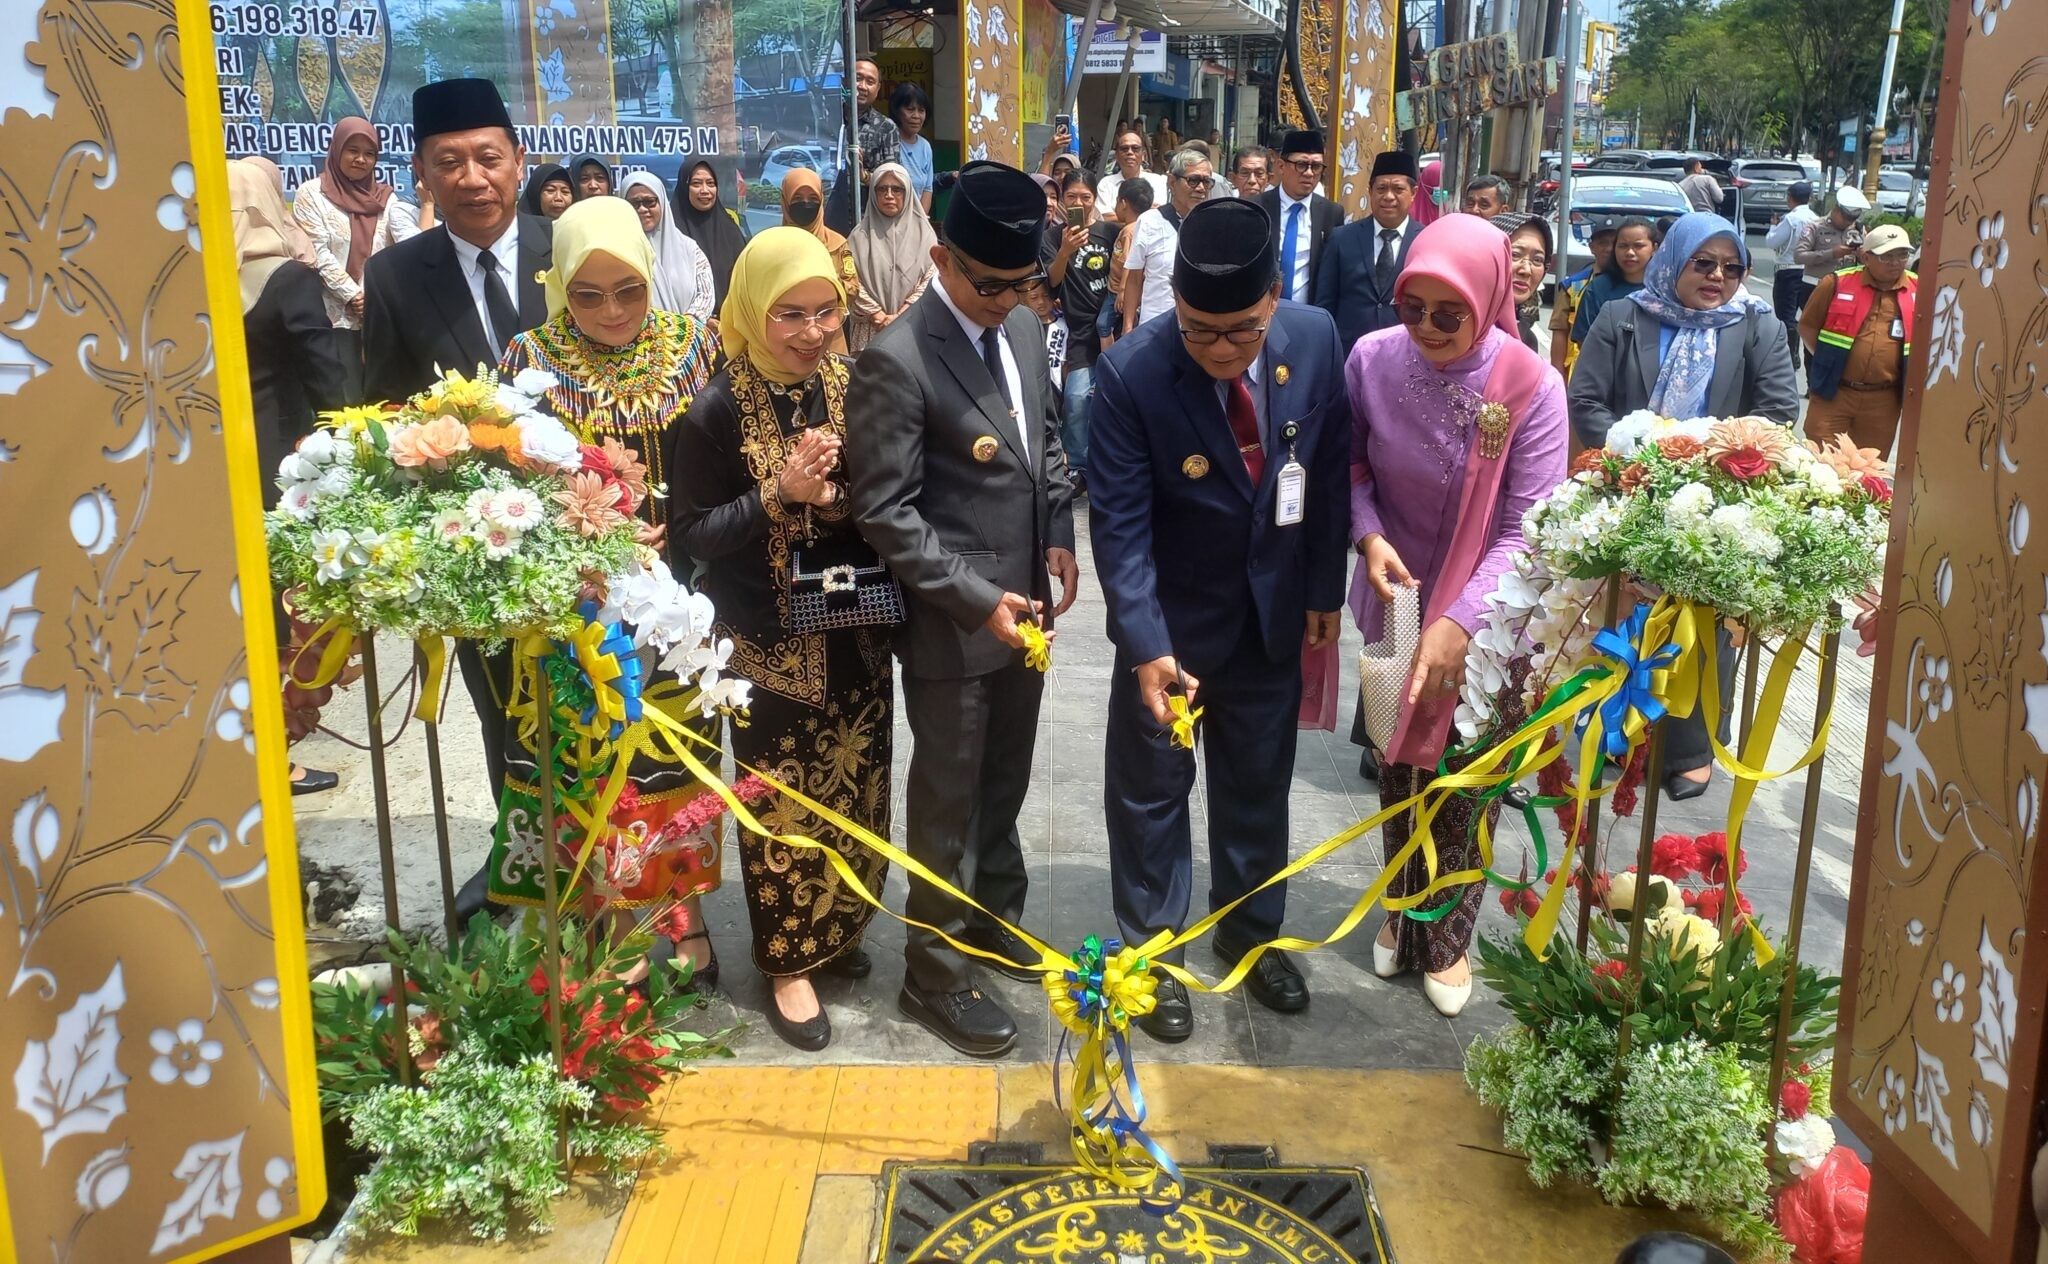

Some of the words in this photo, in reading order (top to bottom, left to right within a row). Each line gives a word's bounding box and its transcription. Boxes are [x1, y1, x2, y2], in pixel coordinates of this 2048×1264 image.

[211, 4, 377, 36] 6.198.318.47
[217, 47, 243, 75] RI
[1438, 36, 1509, 83] GANG
[1493, 60, 1547, 105] SARI
[514, 125, 646, 155] NANGANAN
[652, 126, 692, 155] 475
[697, 126, 719, 155] M
